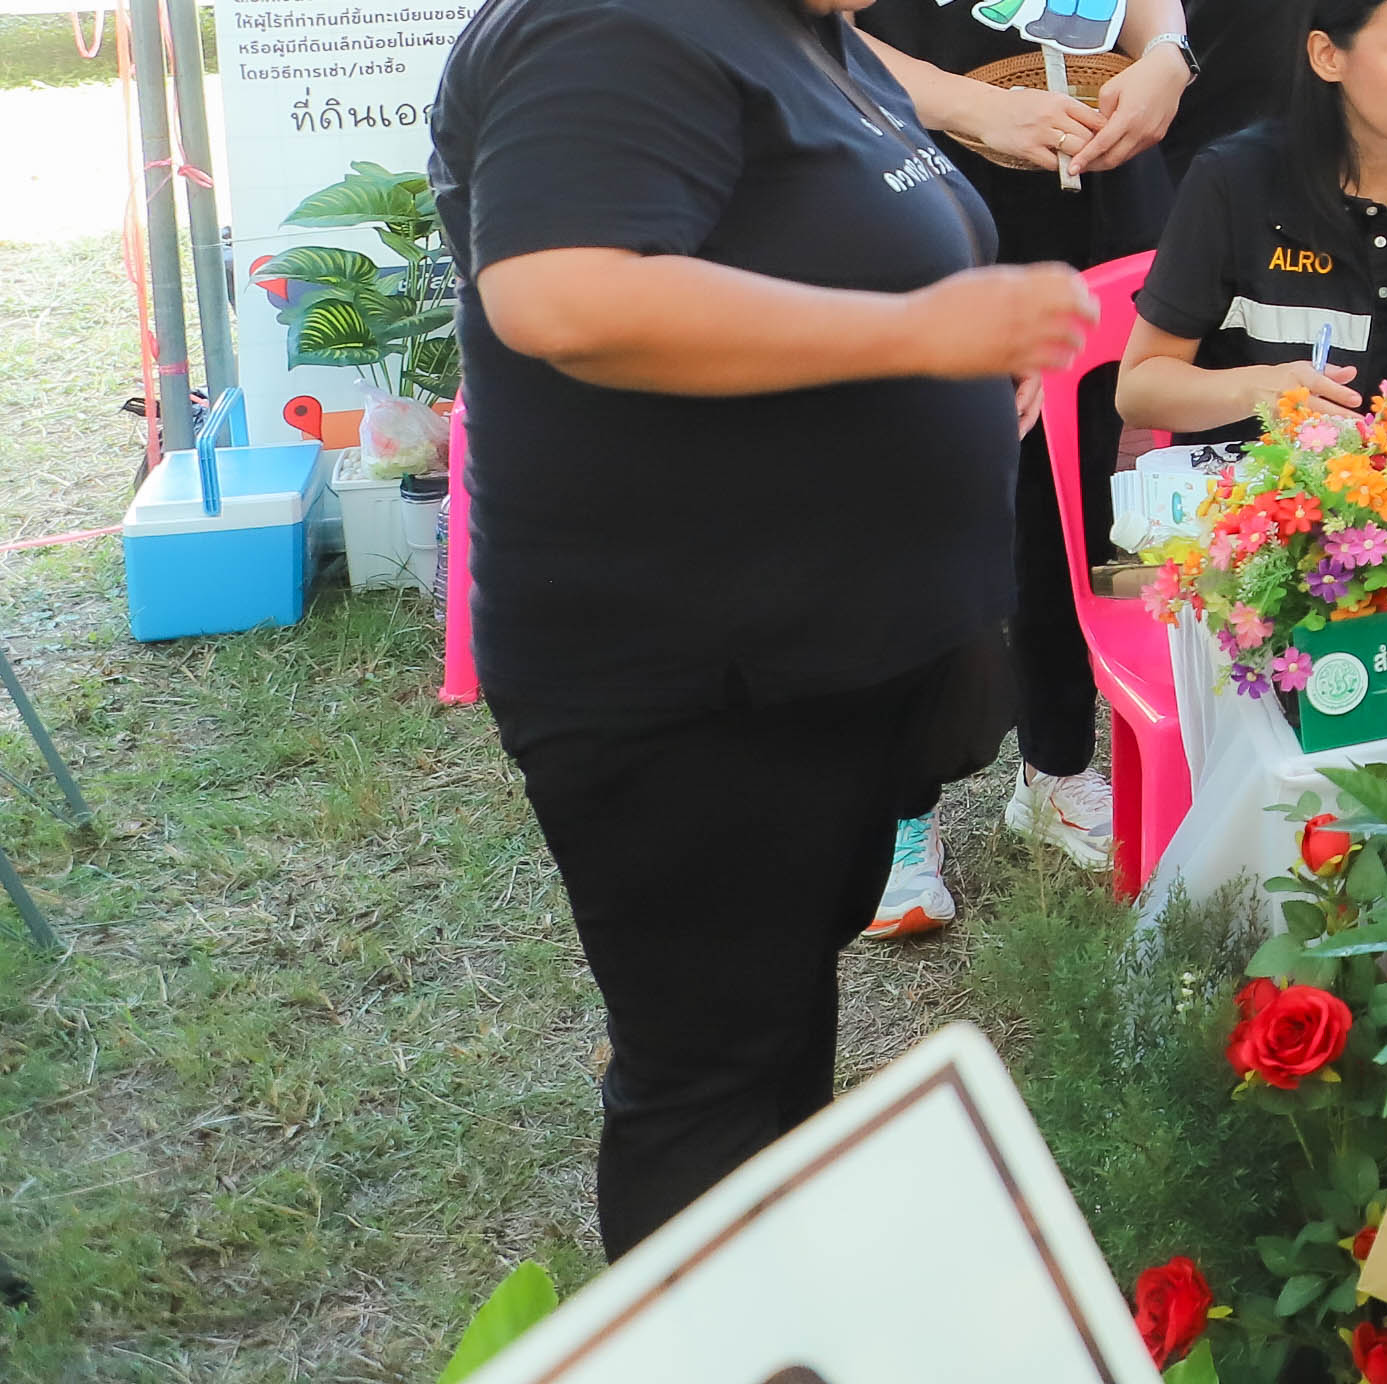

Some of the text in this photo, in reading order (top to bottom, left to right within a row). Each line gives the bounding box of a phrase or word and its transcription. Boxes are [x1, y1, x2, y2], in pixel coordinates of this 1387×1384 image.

[239, 32, 458, 58] หรือผู้มีที่ดินเล็กน้อยไม่เพียง
[241, 61, 406, 81] โดยวิธีการเช่า/เช่าซื้อ
[291, 87, 434, 132] ที่ดินเอก
[1268, 246, 1333, 274] ALRO
